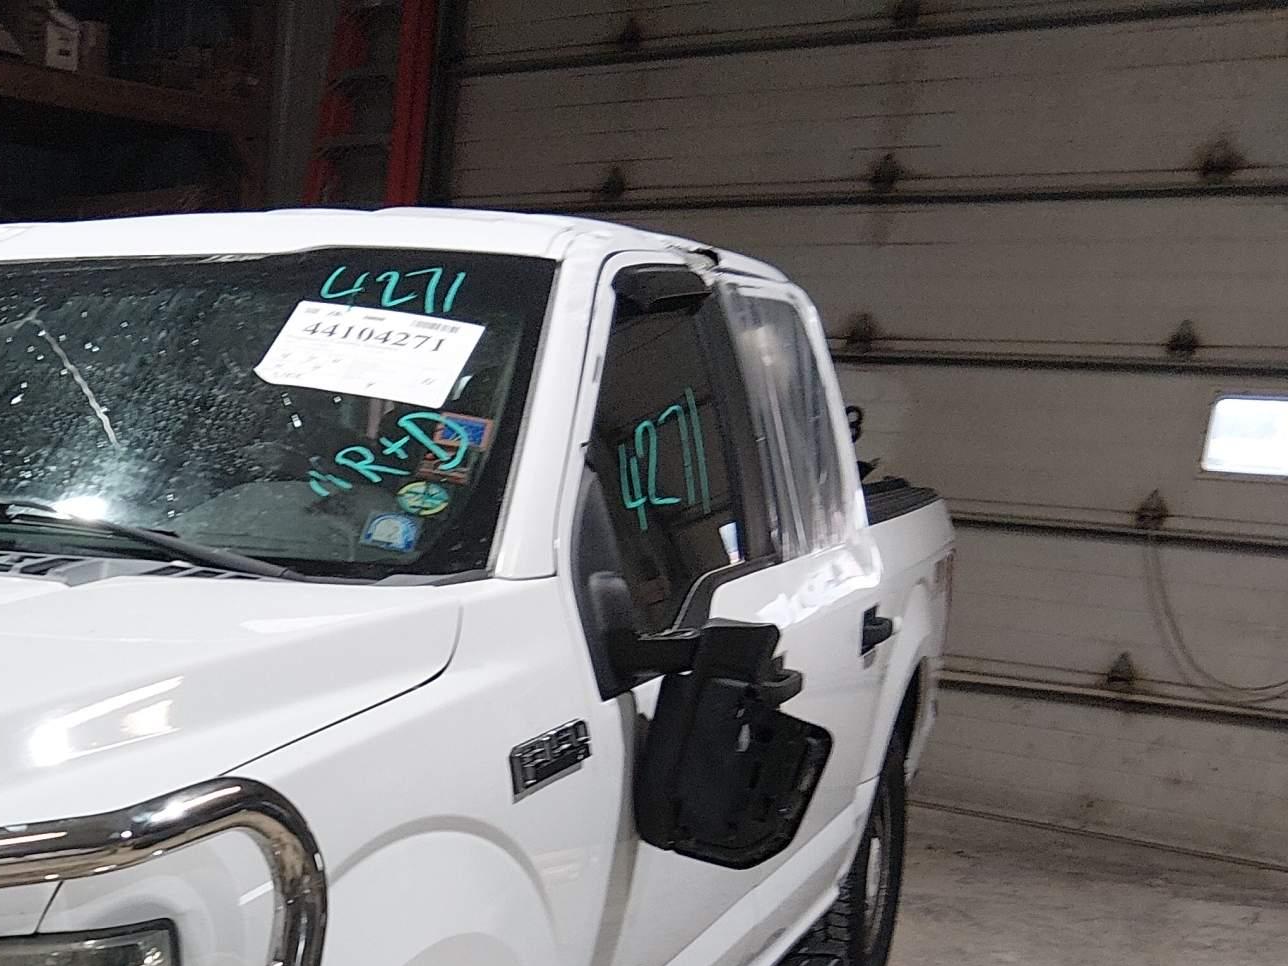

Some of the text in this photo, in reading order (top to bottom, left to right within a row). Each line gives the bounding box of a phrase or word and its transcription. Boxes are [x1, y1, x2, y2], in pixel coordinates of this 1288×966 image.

[320, 266, 467, 314] 4271
[303, 321, 447, 352] 44104271
[618, 387, 712, 530] 4271
